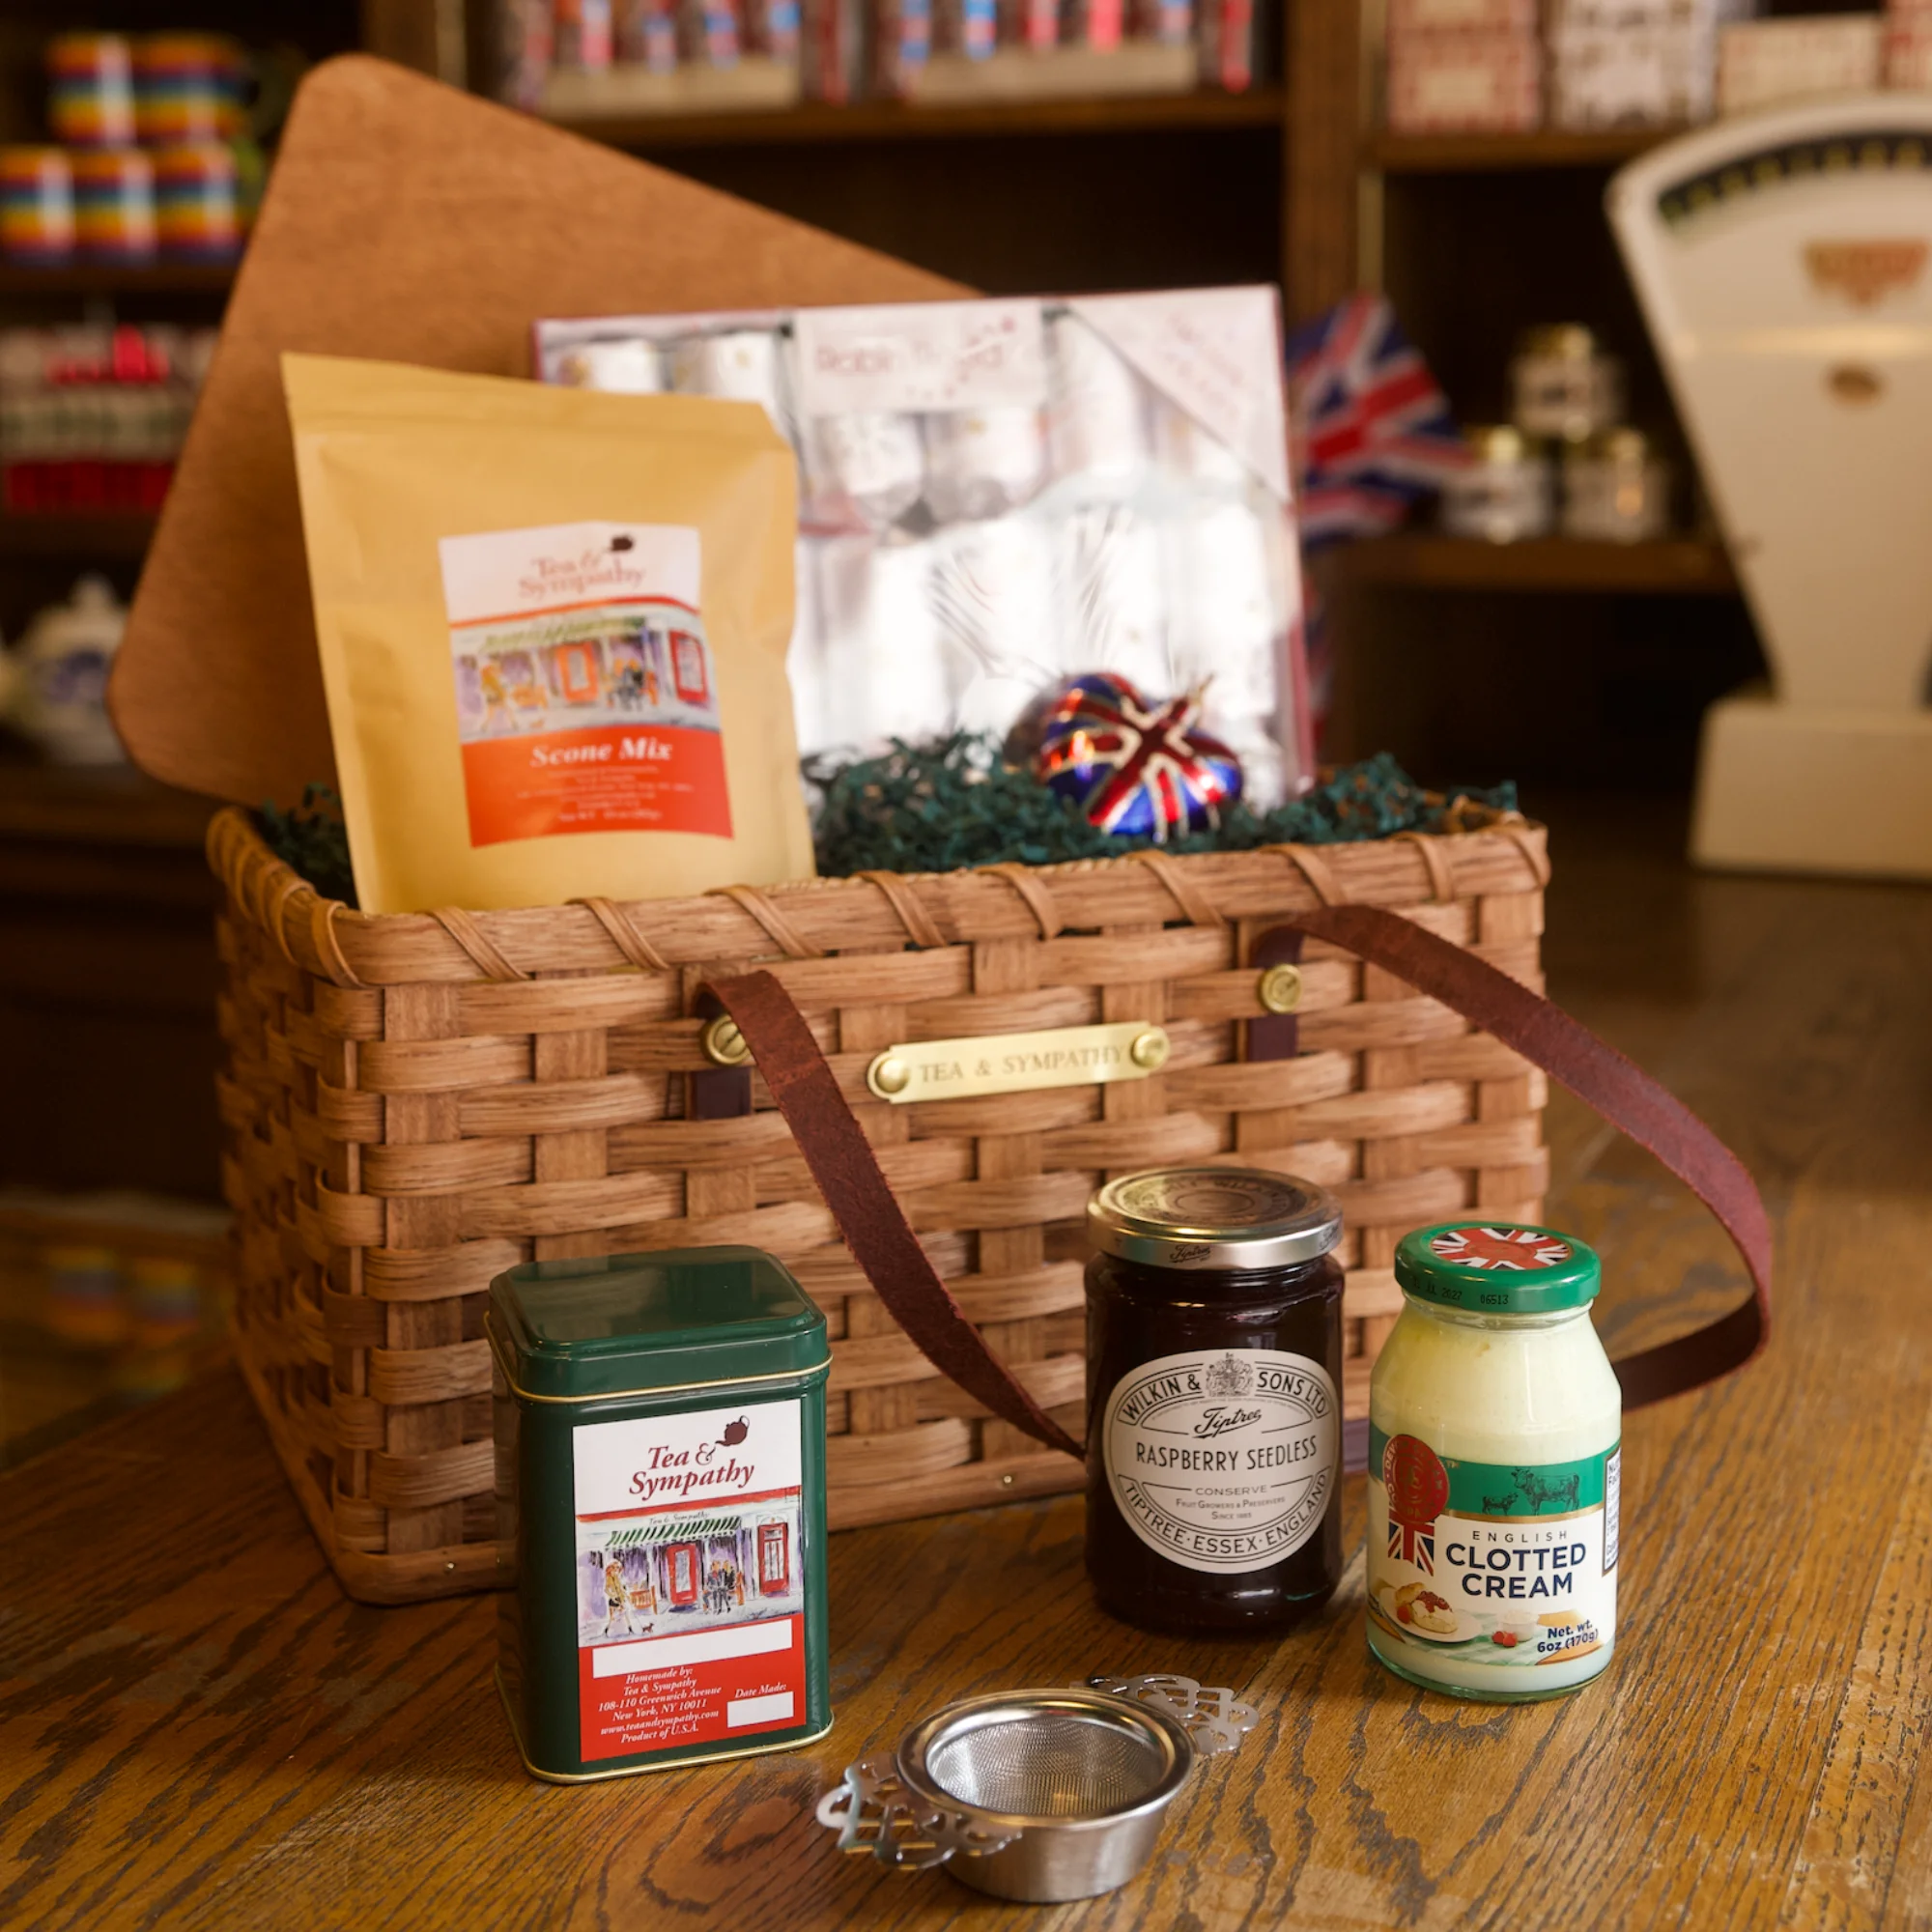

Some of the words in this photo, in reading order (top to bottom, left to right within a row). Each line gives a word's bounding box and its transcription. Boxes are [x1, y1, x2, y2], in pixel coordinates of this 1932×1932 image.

[519, 557, 646, 600] Sympathy
[535, 556, 576, 580] Tea
[530, 740, 613, 768] Scone
[619, 736, 673, 761] Mix
[919, 1063, 964, 1083] TEA
[975, 1059, 992, 1076] &
[1002, 1044, 1123, 1074] SYMPATHY
[1122, 1377, 1181, 1420] WILKIN
[1187, 1373, 1201, 1391] &
[1257, 1371, 1305, 1396] SONS
[1305, 1384, 1326, 1414] LTD
[1192, 1406, 1263, 1438] Tiptree
[648, 1445, 690, 1470] Tea
[696, 1443, 716, 1465] &
[1136, 1441, 1239, 1471] RASPBERRY
[1247, 1435, 1318, 1470] SEEDLESS
[629, 1459, 755, 1501] Sympathy
[1195, 1485, 1267, 1496] CONSERVE
[1125, 1482, 1188, 1543] TIPTREE
[1193, 1535, 1258, 1553] ESSEX
[1265, 1474, 1327, 1546] ENGLAND
[1472, 1530, 1568, 1543] ENGLISH
[1445, 1543, 1587, 1571] CLOTTED
[1462, 1572, 1574, 1600] CREAM
[1537, 1642, 1562, 1653] 6oz
[1565, 1629, 1599, 1649] (170g)
[1548, 1625, 1574, 1638] Net.
[1577, 1619, 1593, 1633] wt.
[623, 1686, 639, 1696] Tea
[640, 1684, 649, 1693] &
[652, 1678, 697, 1693] Sympathy
[626, 1667, 677, 1684] Homemade
[679, 1666, 694, 1679] by:
[598, 1698, 637, 1712] 108-110
[639, 1690, 687, 1705] Greenwich
[689, 1687, 722, 1698] Avenue
[735, 1687, 757, 1699] Date
[758, 1683, 787, 1695] Made:
[612, 1711, 633, 1721] New
[636, 1706, 659, 1718] York,
[661, 1702, 678, 1714] NY
[679, 1698, 707, 1711] 10011
[621, 1728, 657, 1744] Product
[659, 1726, 670, 1740] of
[670, 1723, 699, 1736] U.S.A.
